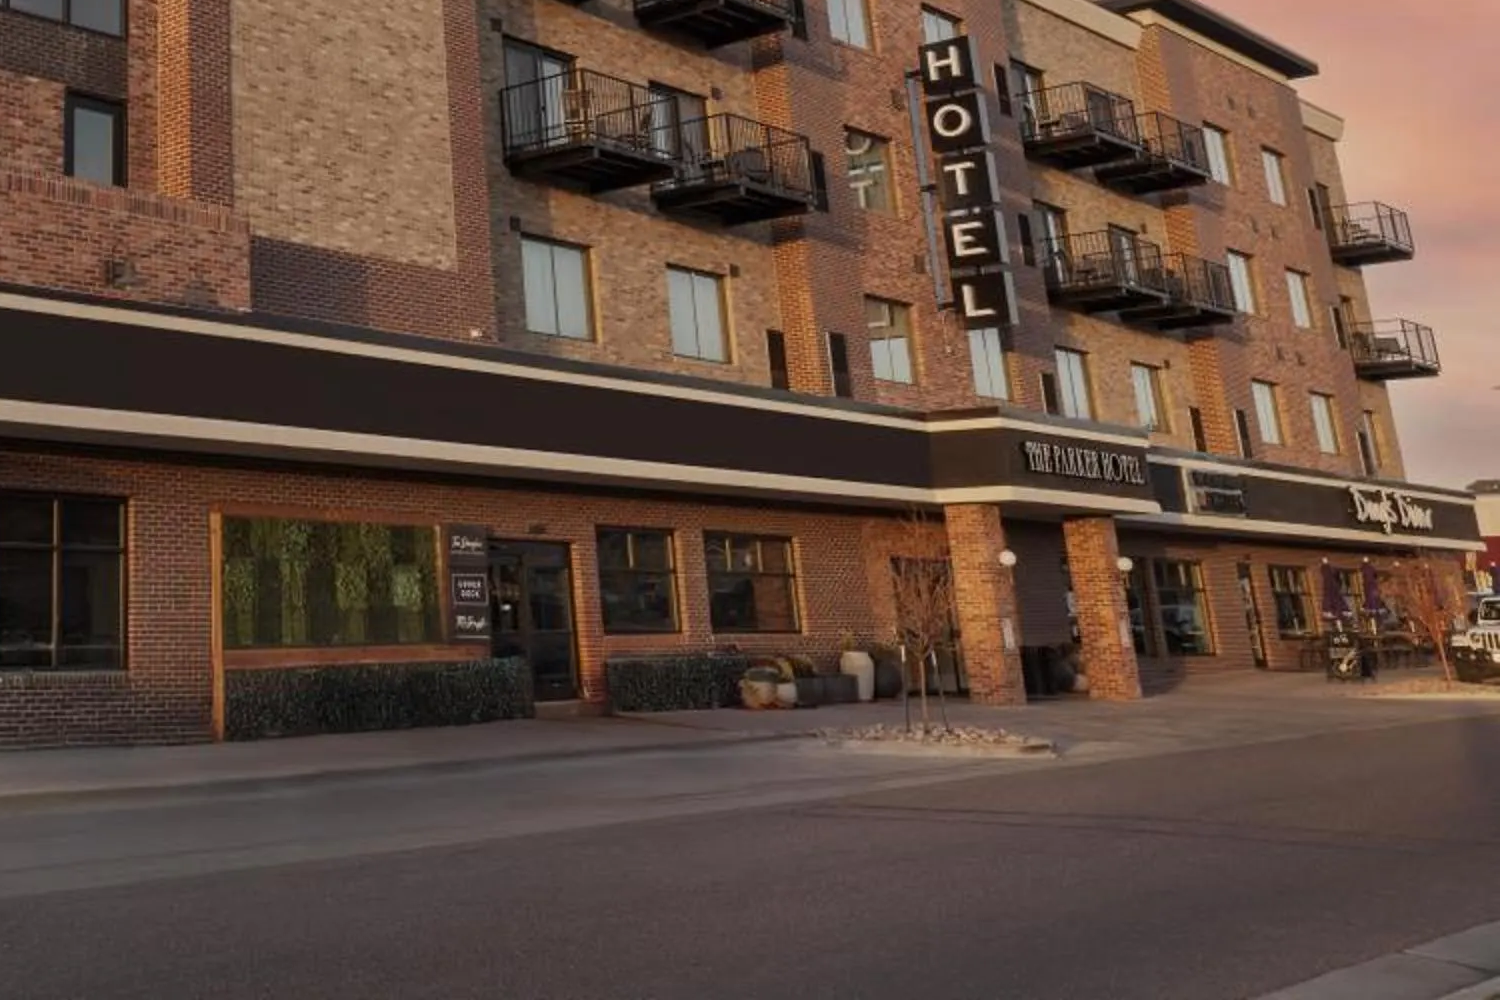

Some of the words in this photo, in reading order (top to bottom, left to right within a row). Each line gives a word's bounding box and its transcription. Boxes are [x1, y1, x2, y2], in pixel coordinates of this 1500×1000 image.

[926, 45, 996, 318] HOTEL
[1025, 441, 1052, 473] THE
[1053, 446, 1101, 479] PARKER
[1101, 451, 1146, 484] HOTEL
